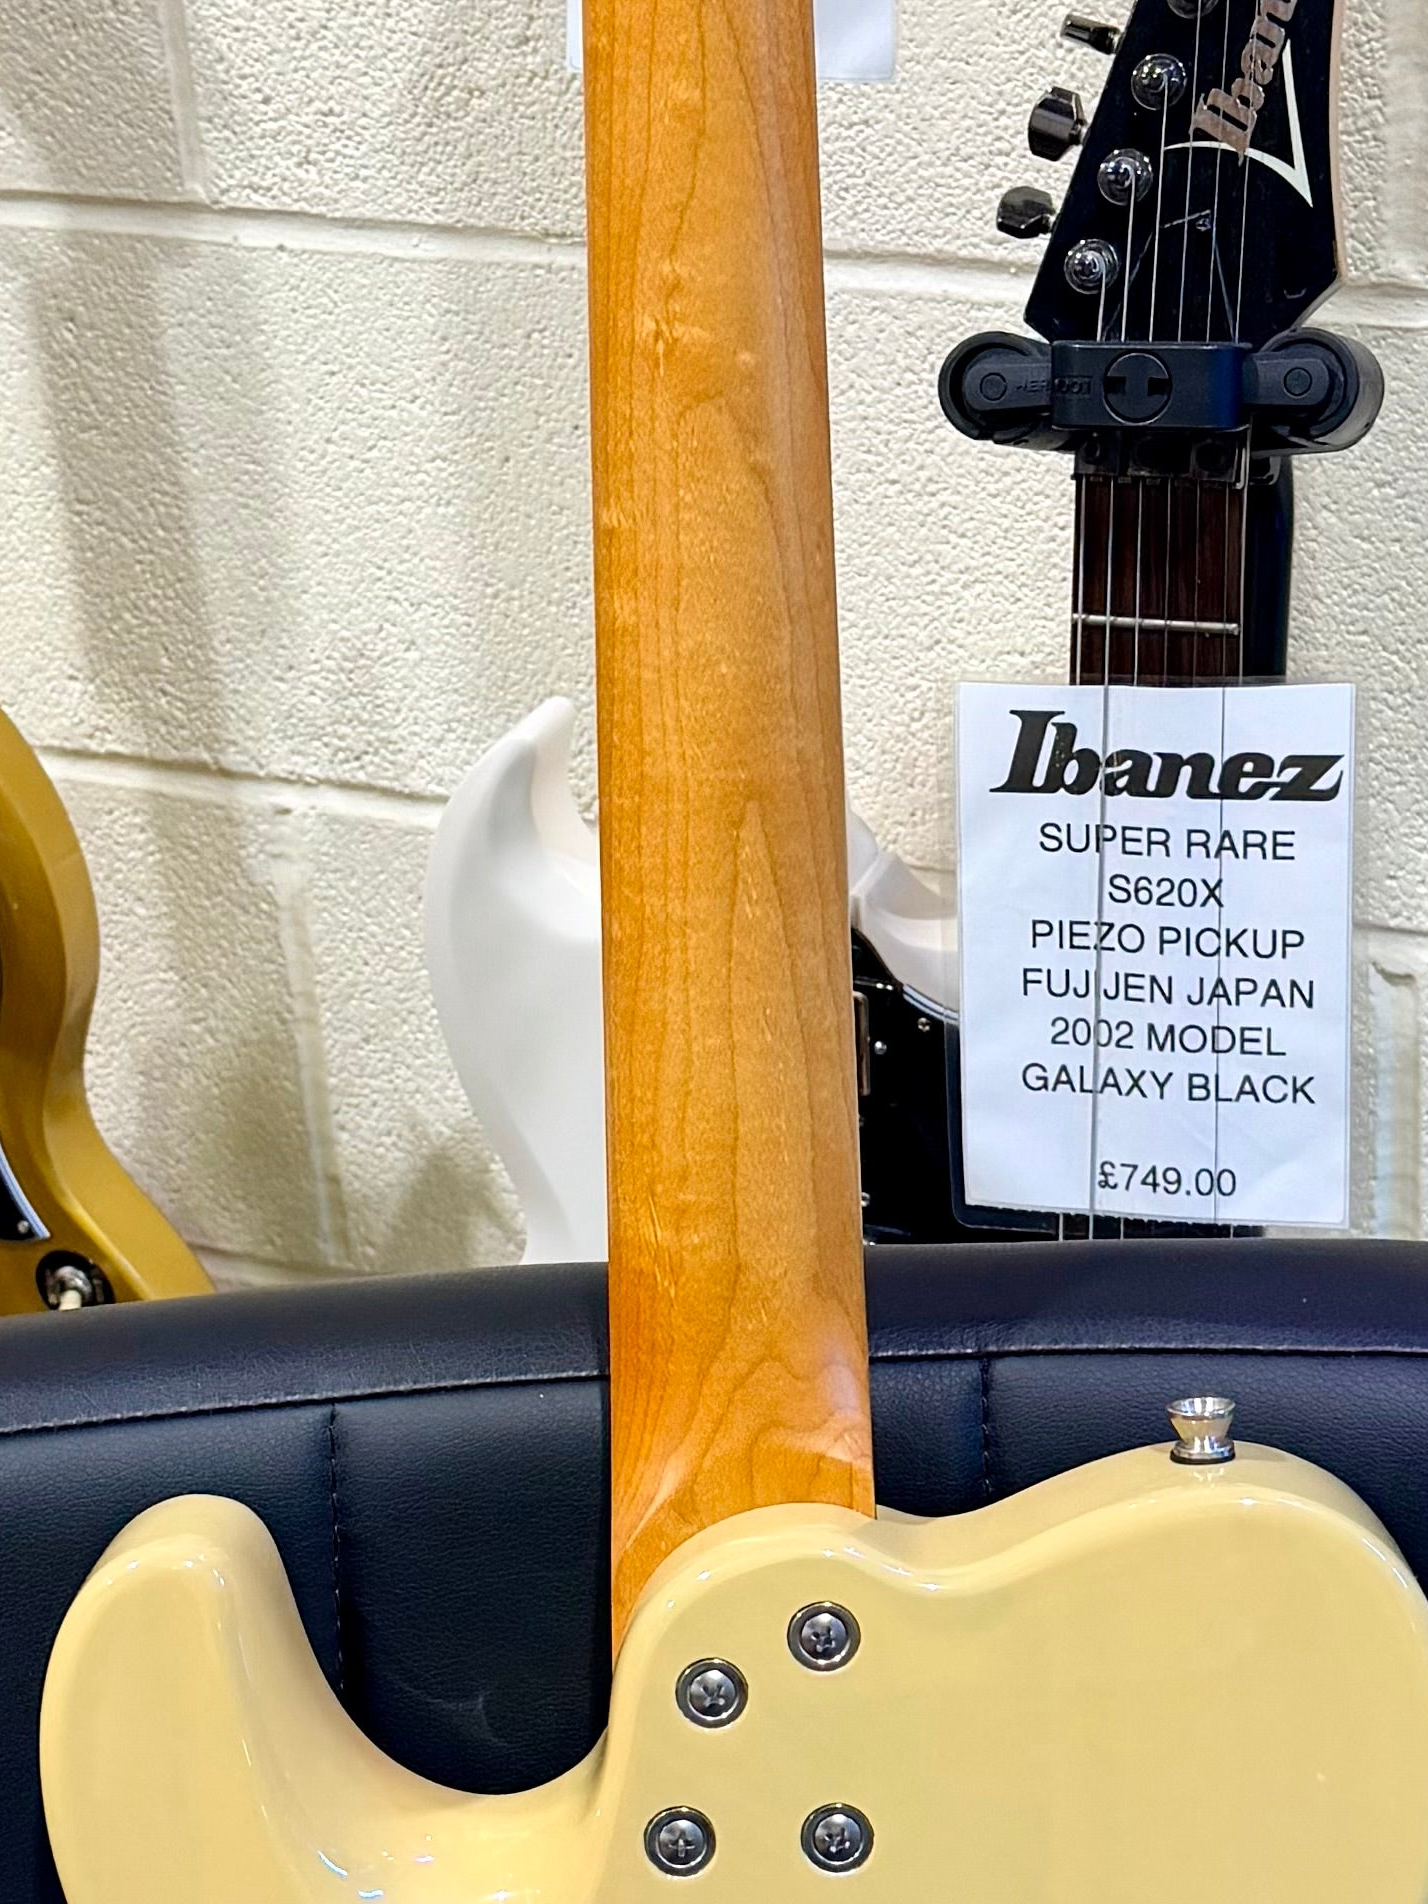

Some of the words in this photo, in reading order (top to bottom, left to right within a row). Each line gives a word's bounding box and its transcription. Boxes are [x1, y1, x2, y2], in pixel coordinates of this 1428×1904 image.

[989, 708, 1346, 802] Ibanez
[1039, 823, 1171, 858] SUPER
[1186, 829, 1296, 861] RARE
[1108, 873, 1225, 909] S620X
[1031, 919, 1145, 954] PIEZO
[1158, 925, 1306, 960] PICKUP
[1022, 967, 1174, 1005] FUJJEN
[1187, 977, 1315, 1009] JAPAN
[1051, 1016, 1135, 1050] 2002
[1147, 1023, 1287, 1057] MODEL
[1022, 1062, 1175, 1100] GALAXY
[1188, 1072, 1316, 1105] BLACK
[1098, 1160, 1237, 1197] £749.00
